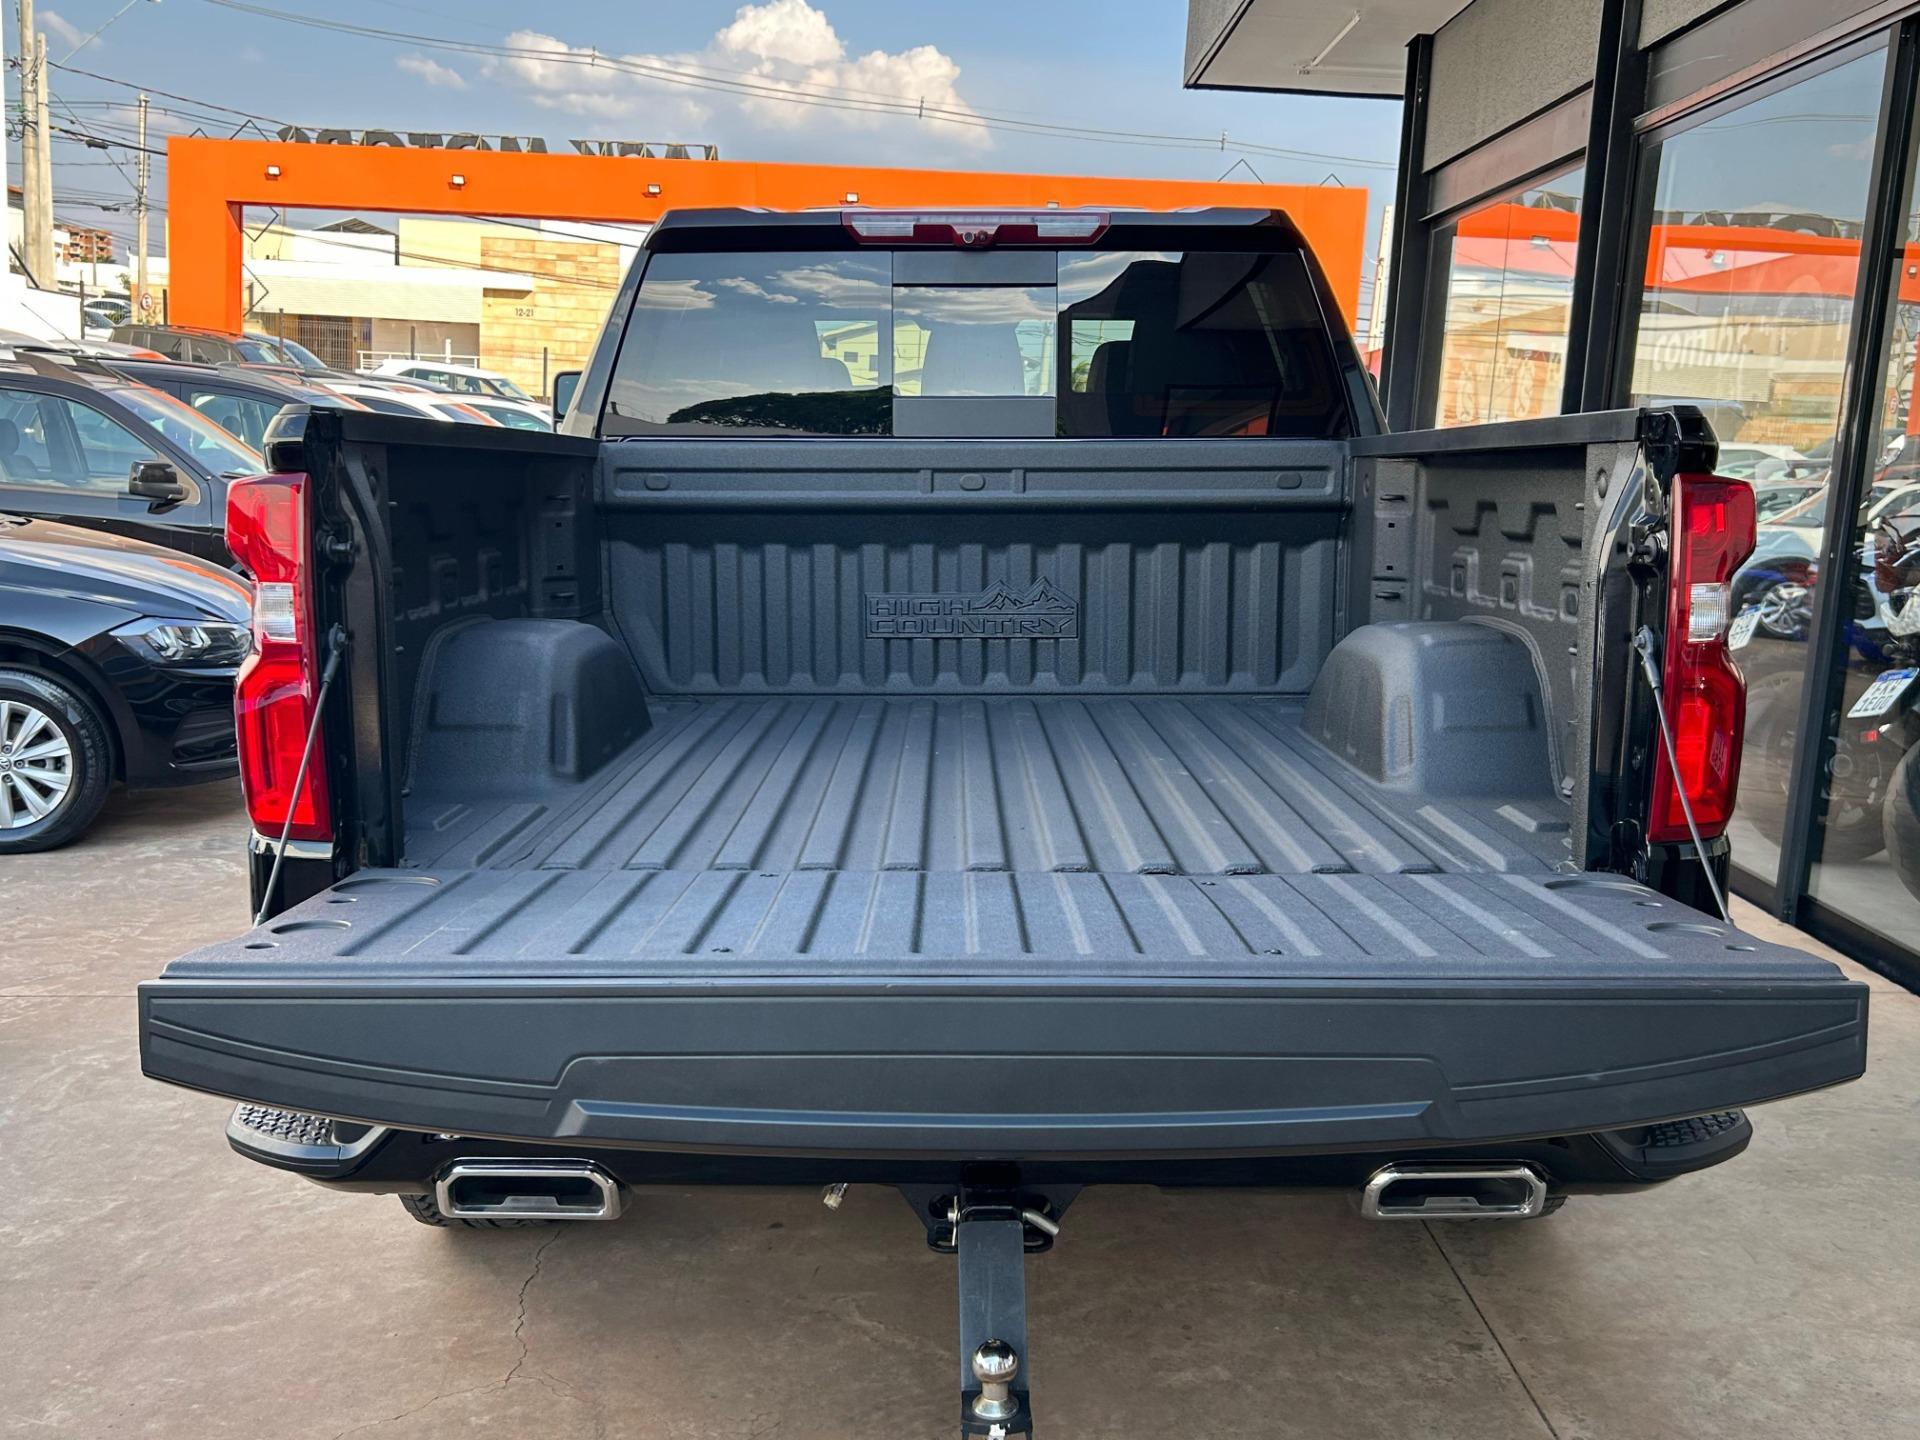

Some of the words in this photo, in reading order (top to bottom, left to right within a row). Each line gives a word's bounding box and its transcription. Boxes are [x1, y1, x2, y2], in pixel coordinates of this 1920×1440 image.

[515, 308, 534, 317] 12-21
[869, 598, 971, 616] HIGH
[869, 617, 1074, 634] COUNTRY
